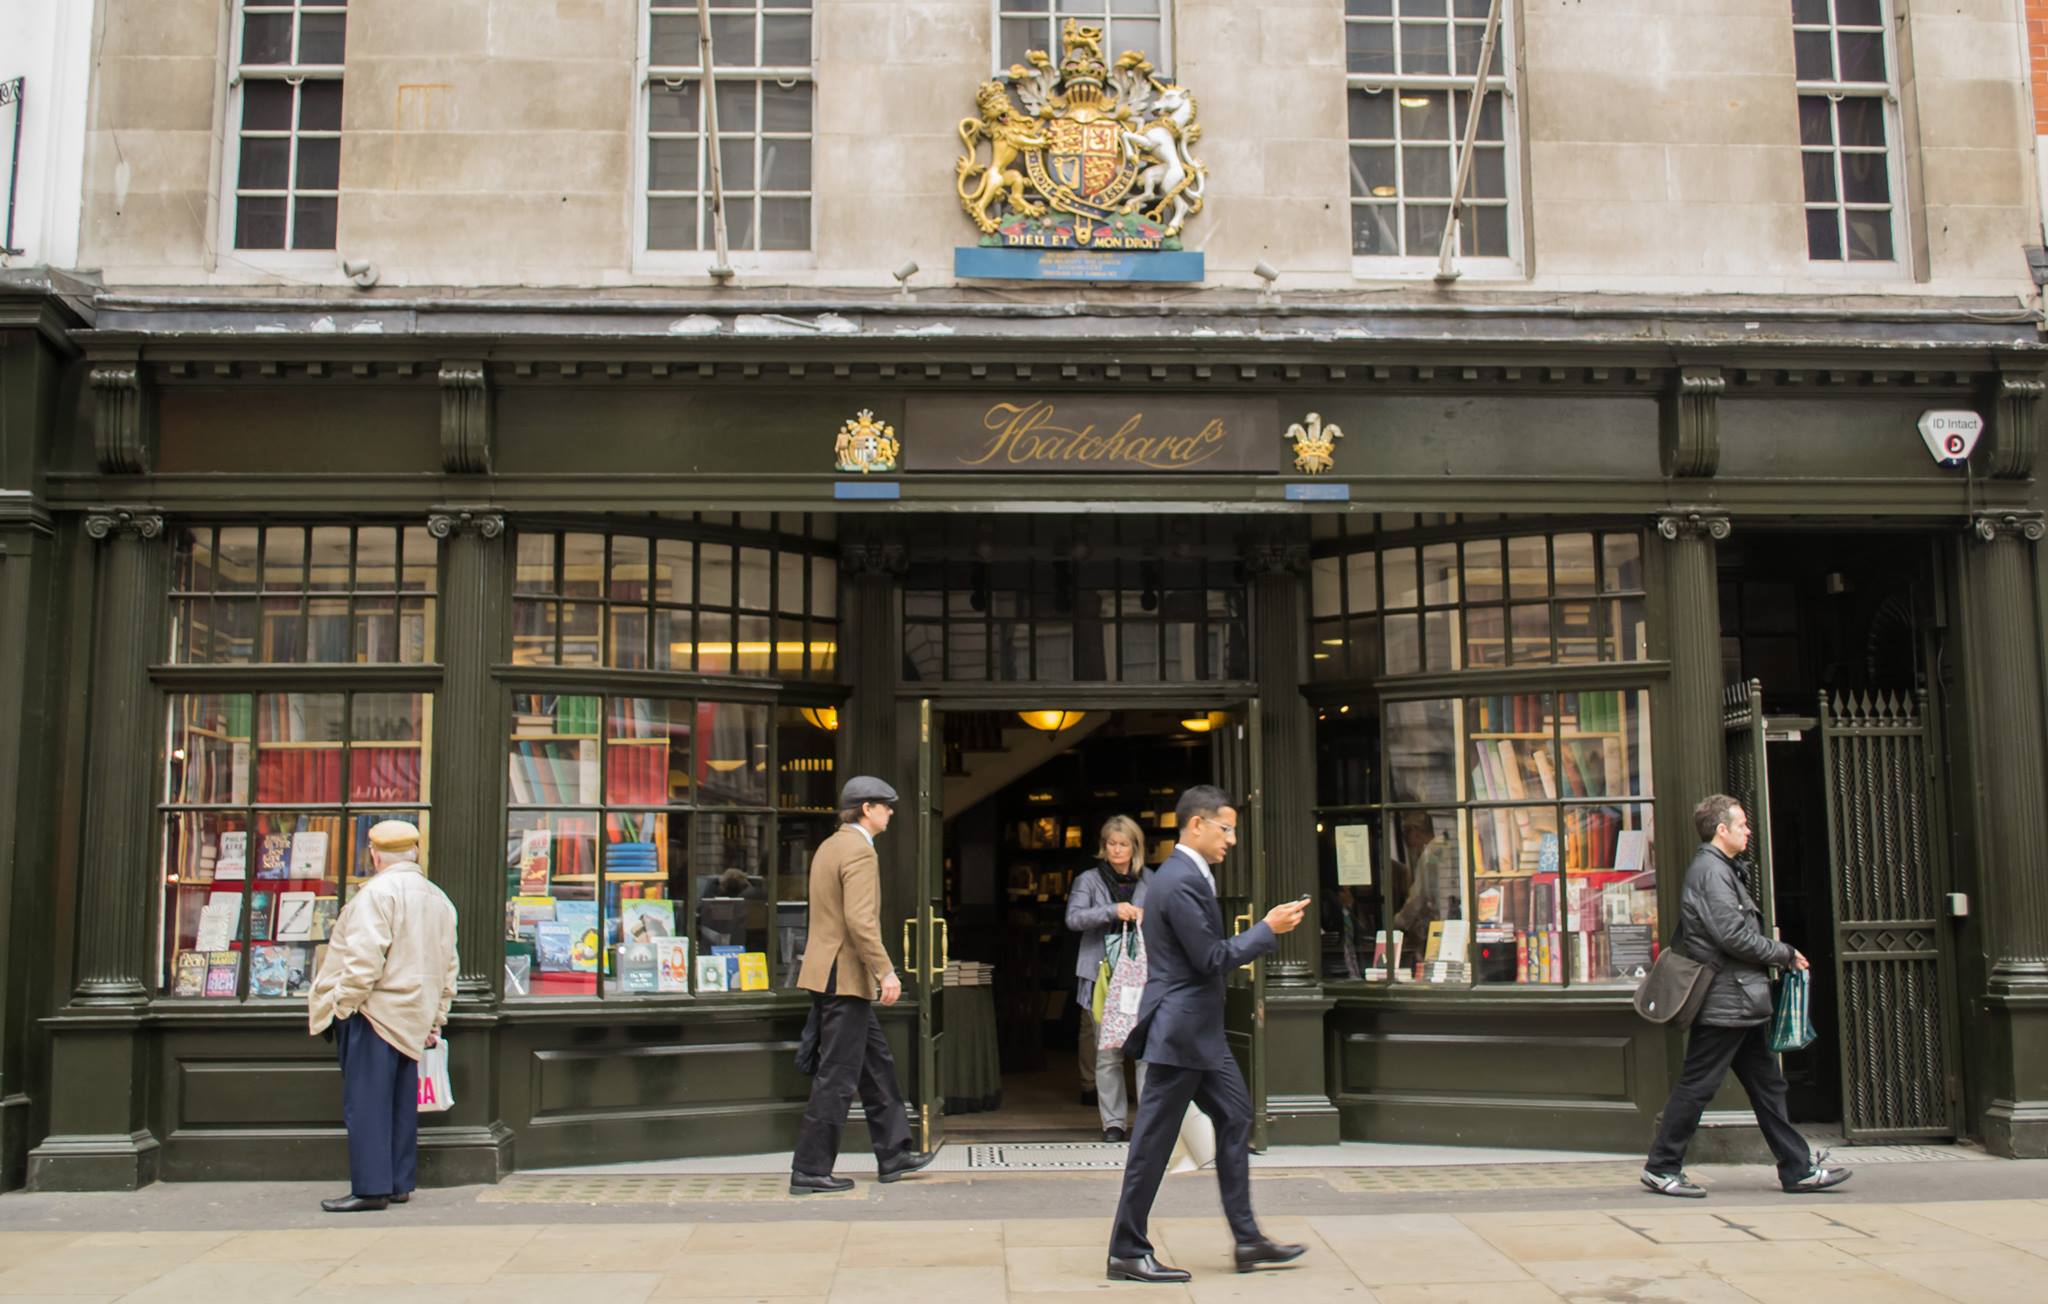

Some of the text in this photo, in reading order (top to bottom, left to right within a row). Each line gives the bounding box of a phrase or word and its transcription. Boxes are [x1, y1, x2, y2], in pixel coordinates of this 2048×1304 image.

[1008, 234, 1070, 246] DIEU ET
[1093, 237, 1162, 249] MON DROIT
[1932, 418, 1978, 429] ID Intact
